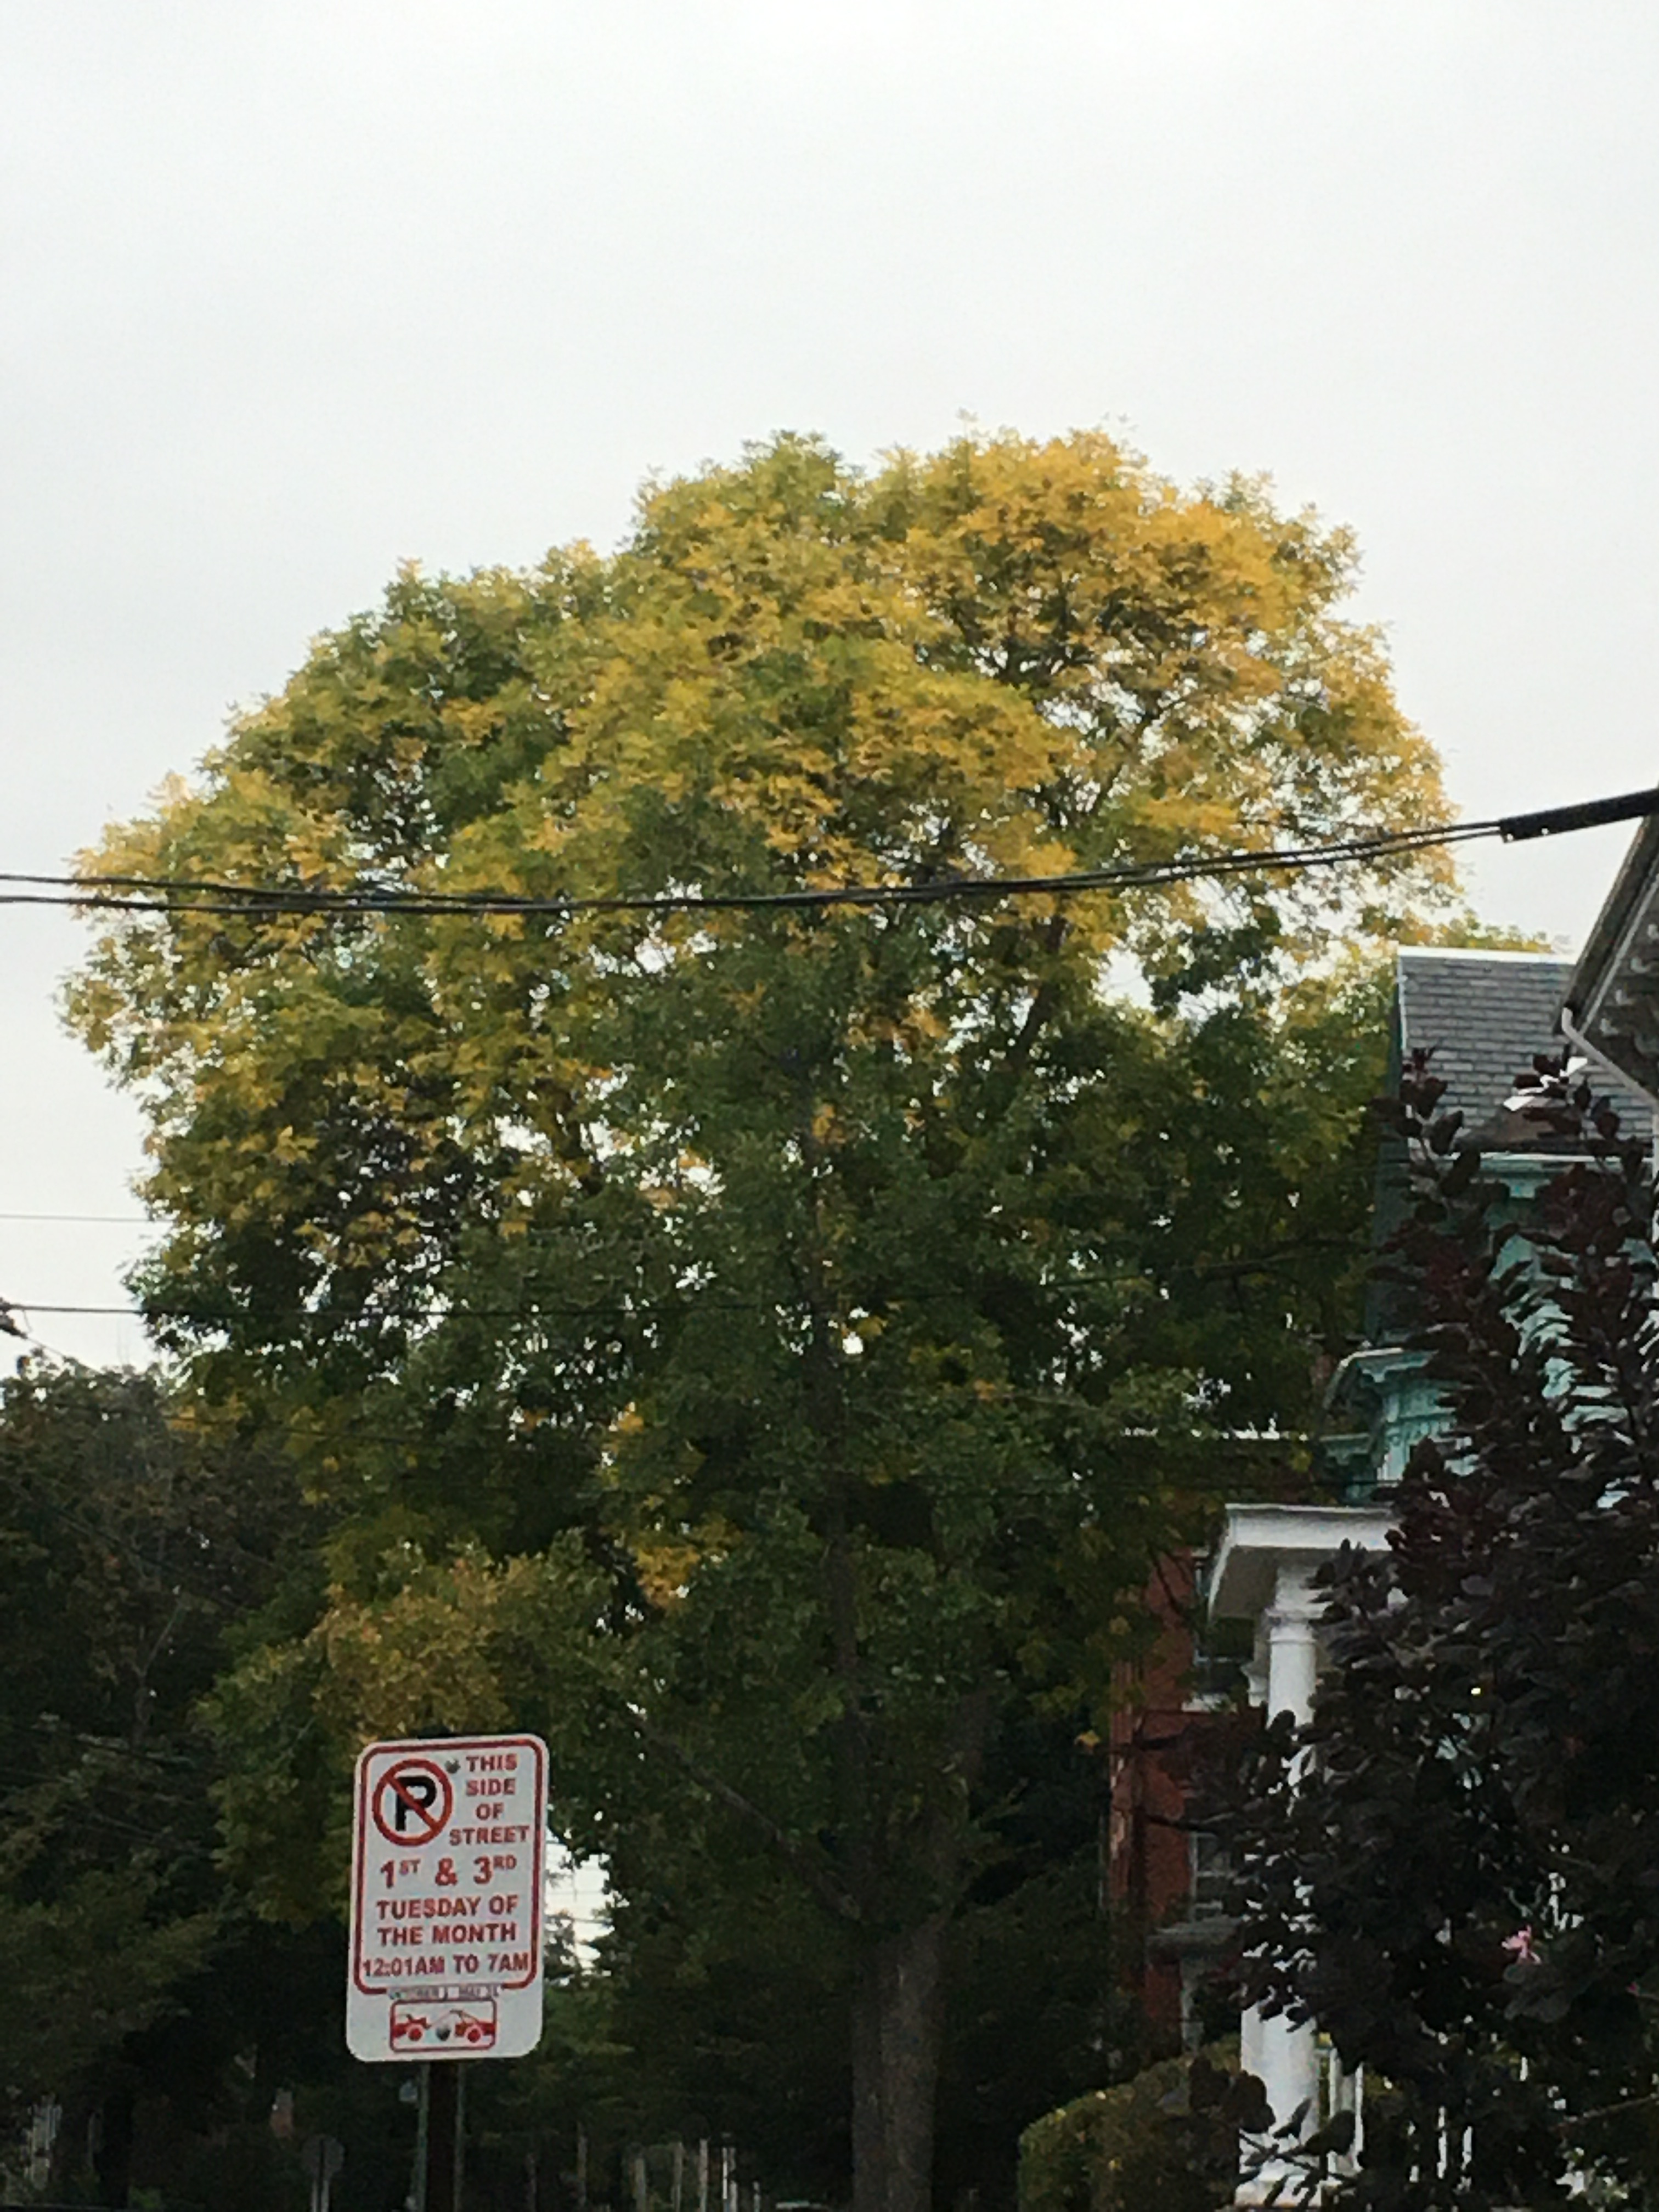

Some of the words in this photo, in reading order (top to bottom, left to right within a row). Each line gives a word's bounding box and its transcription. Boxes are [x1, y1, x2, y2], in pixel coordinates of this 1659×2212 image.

[466, 1754, 517, 1773] THIS
[466, 1778, 516, 1796] SIDE
[476, 1803, 504, 1820] OF
[449, 1825, 530, 1846] STREET
[381, 1859, 421, 1888] 1ST
[435, 1858, 458, 1886] &
[473, 1855, 517, 1885] 3RD
[376, 1898, 481, 1920] TUESDAY
[488, 1895, 518, 1915] OF
[377, 1927, 424, 1946] THE
[432, 1923, 517, 1945] MONTH
[363, 1957, 445, 1977] 12:01AM
[453, 1954, 479, 1974] TO
[487, 1952, 529, 1972] 7AM
